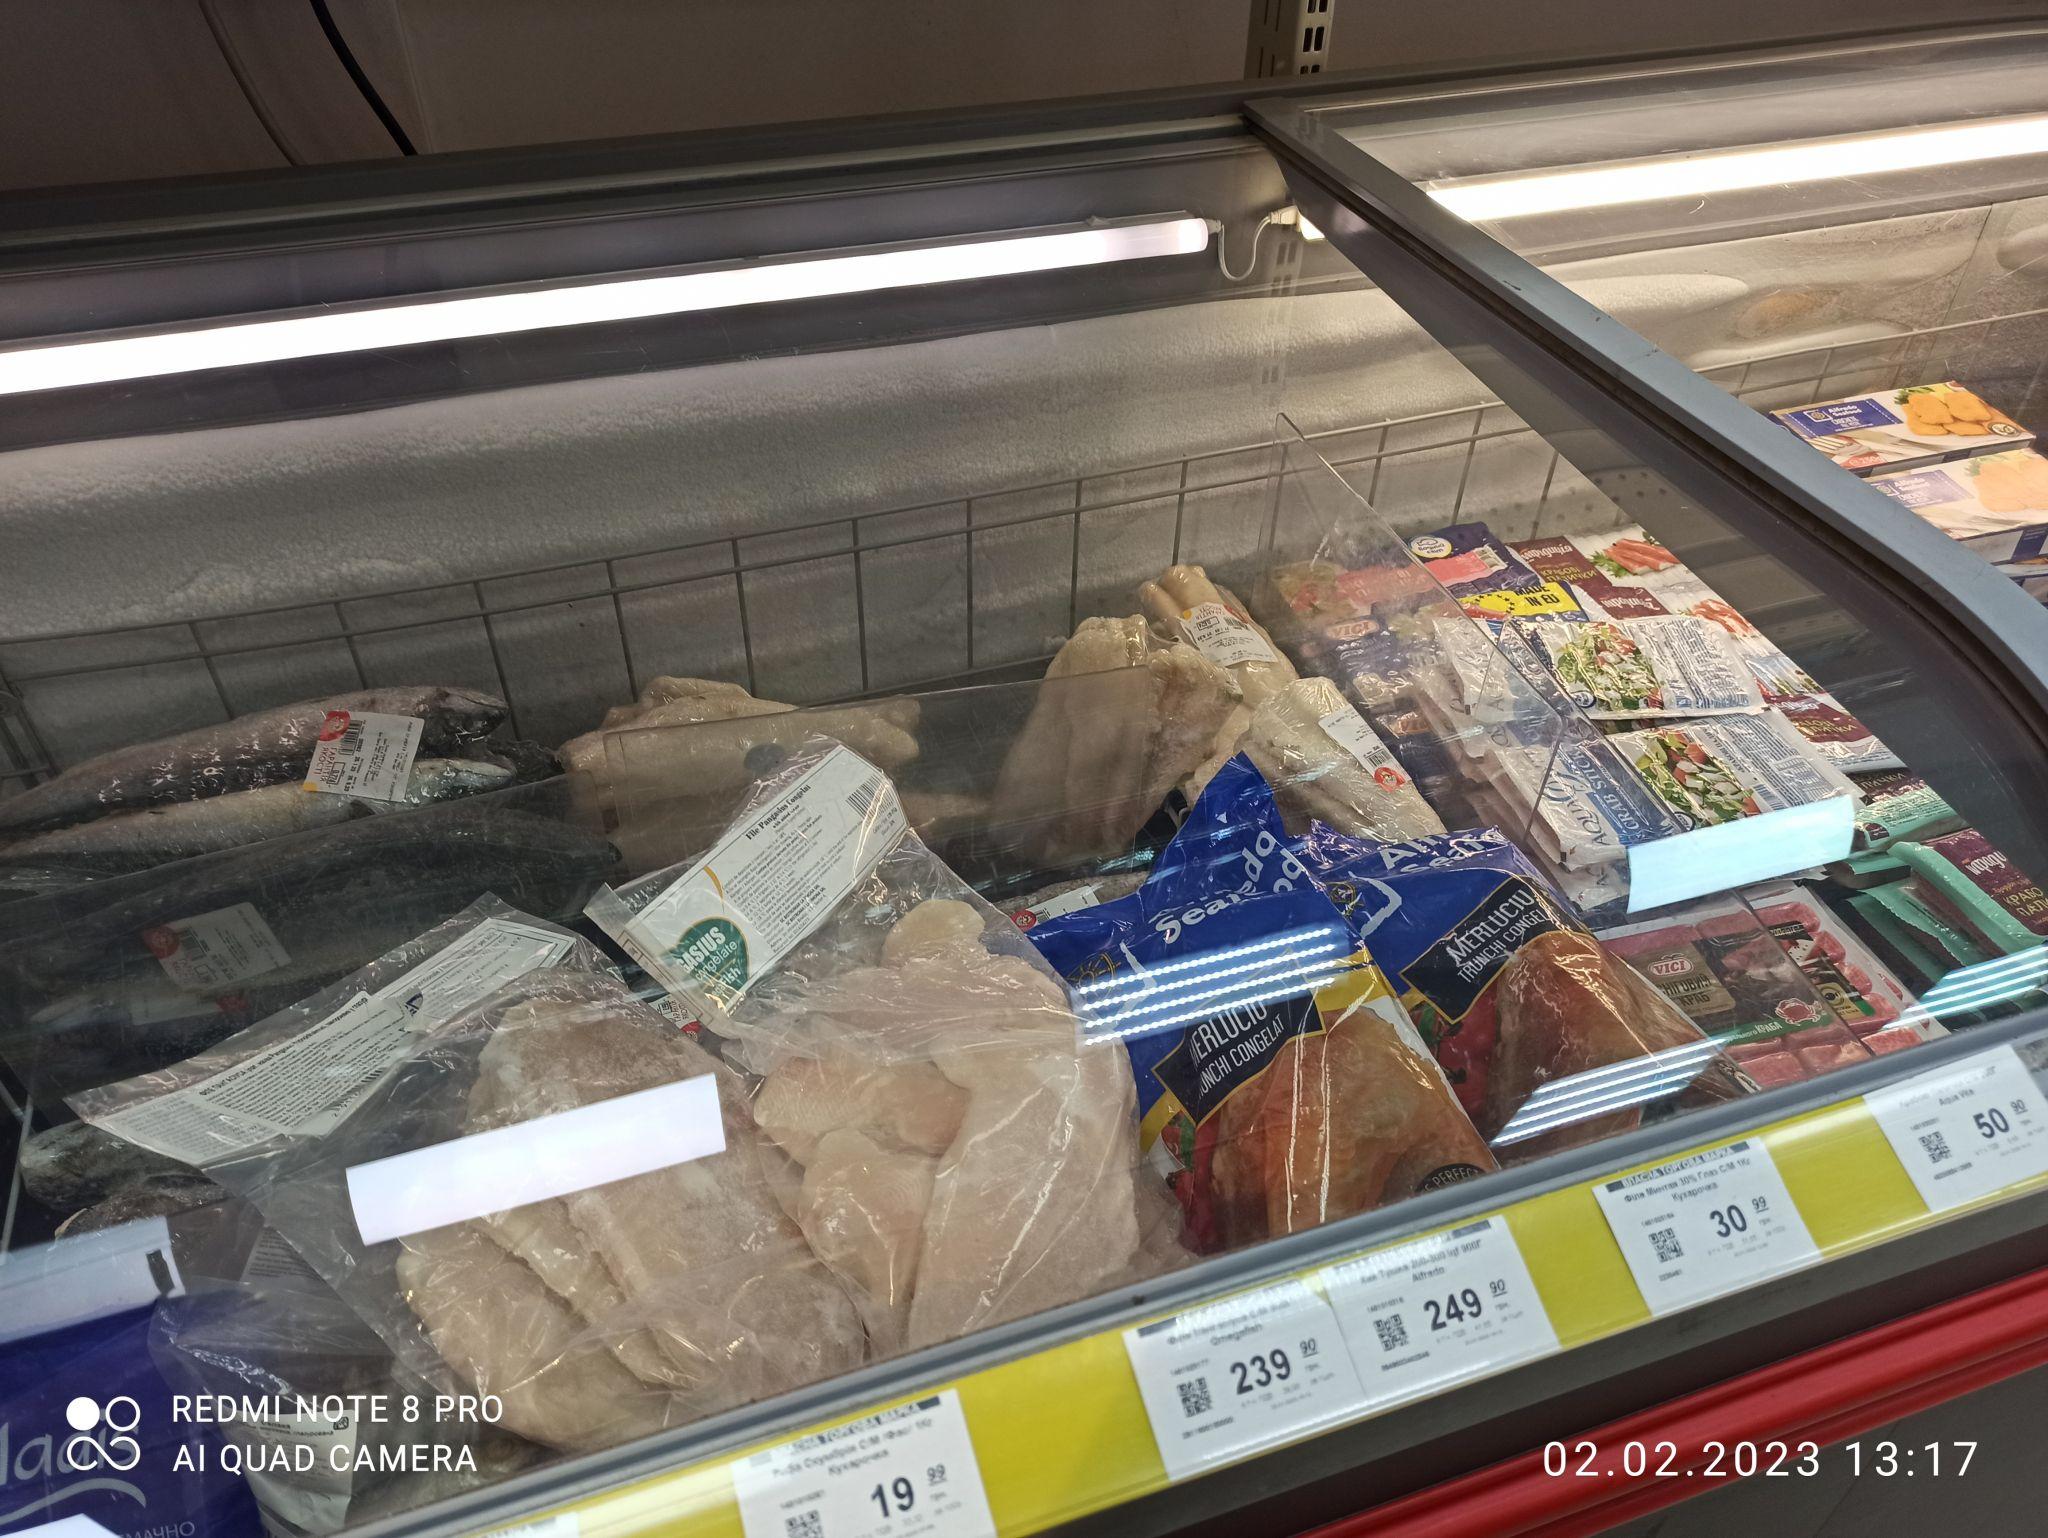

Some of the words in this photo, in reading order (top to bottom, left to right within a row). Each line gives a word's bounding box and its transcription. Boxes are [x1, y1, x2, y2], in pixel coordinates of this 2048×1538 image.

[1514, 584, 1551, 597] MADE
[1526, 596, 1542, 608] IN
[1543, 593, 1561, 606] EU
[1602, 793, 1640, 829] CRAB
[1445, 888, 1535, 968] MERLUCIU
[1457, 940, 1507, 984] TRUNCHI
[1653, 961, 1688, 976] VICI
[1230, 1013, 1286, 1067] CONGELAT
[1973, 1107, 2010, 1139] 50
[2010, 1099, 2027, 1113] 90
[1671, 1182, 1720, 1202] Кухарочка
[1709, 1204, 1748, 1239] 30
[1752, 1195, 1768, 1211] 99
[1412, 1266, 1446, 1283] Alfredo
[1423, 1287, 1483, 1332] 249
[1489, 1278, 1507, 1294] 90
[1229, 1347, 1291, 1396] 239
[1299, 1337, 1318, 1354] 90
[870, 1476, 915, 1519] 19
[926, 1463, 947, 1481] 99
